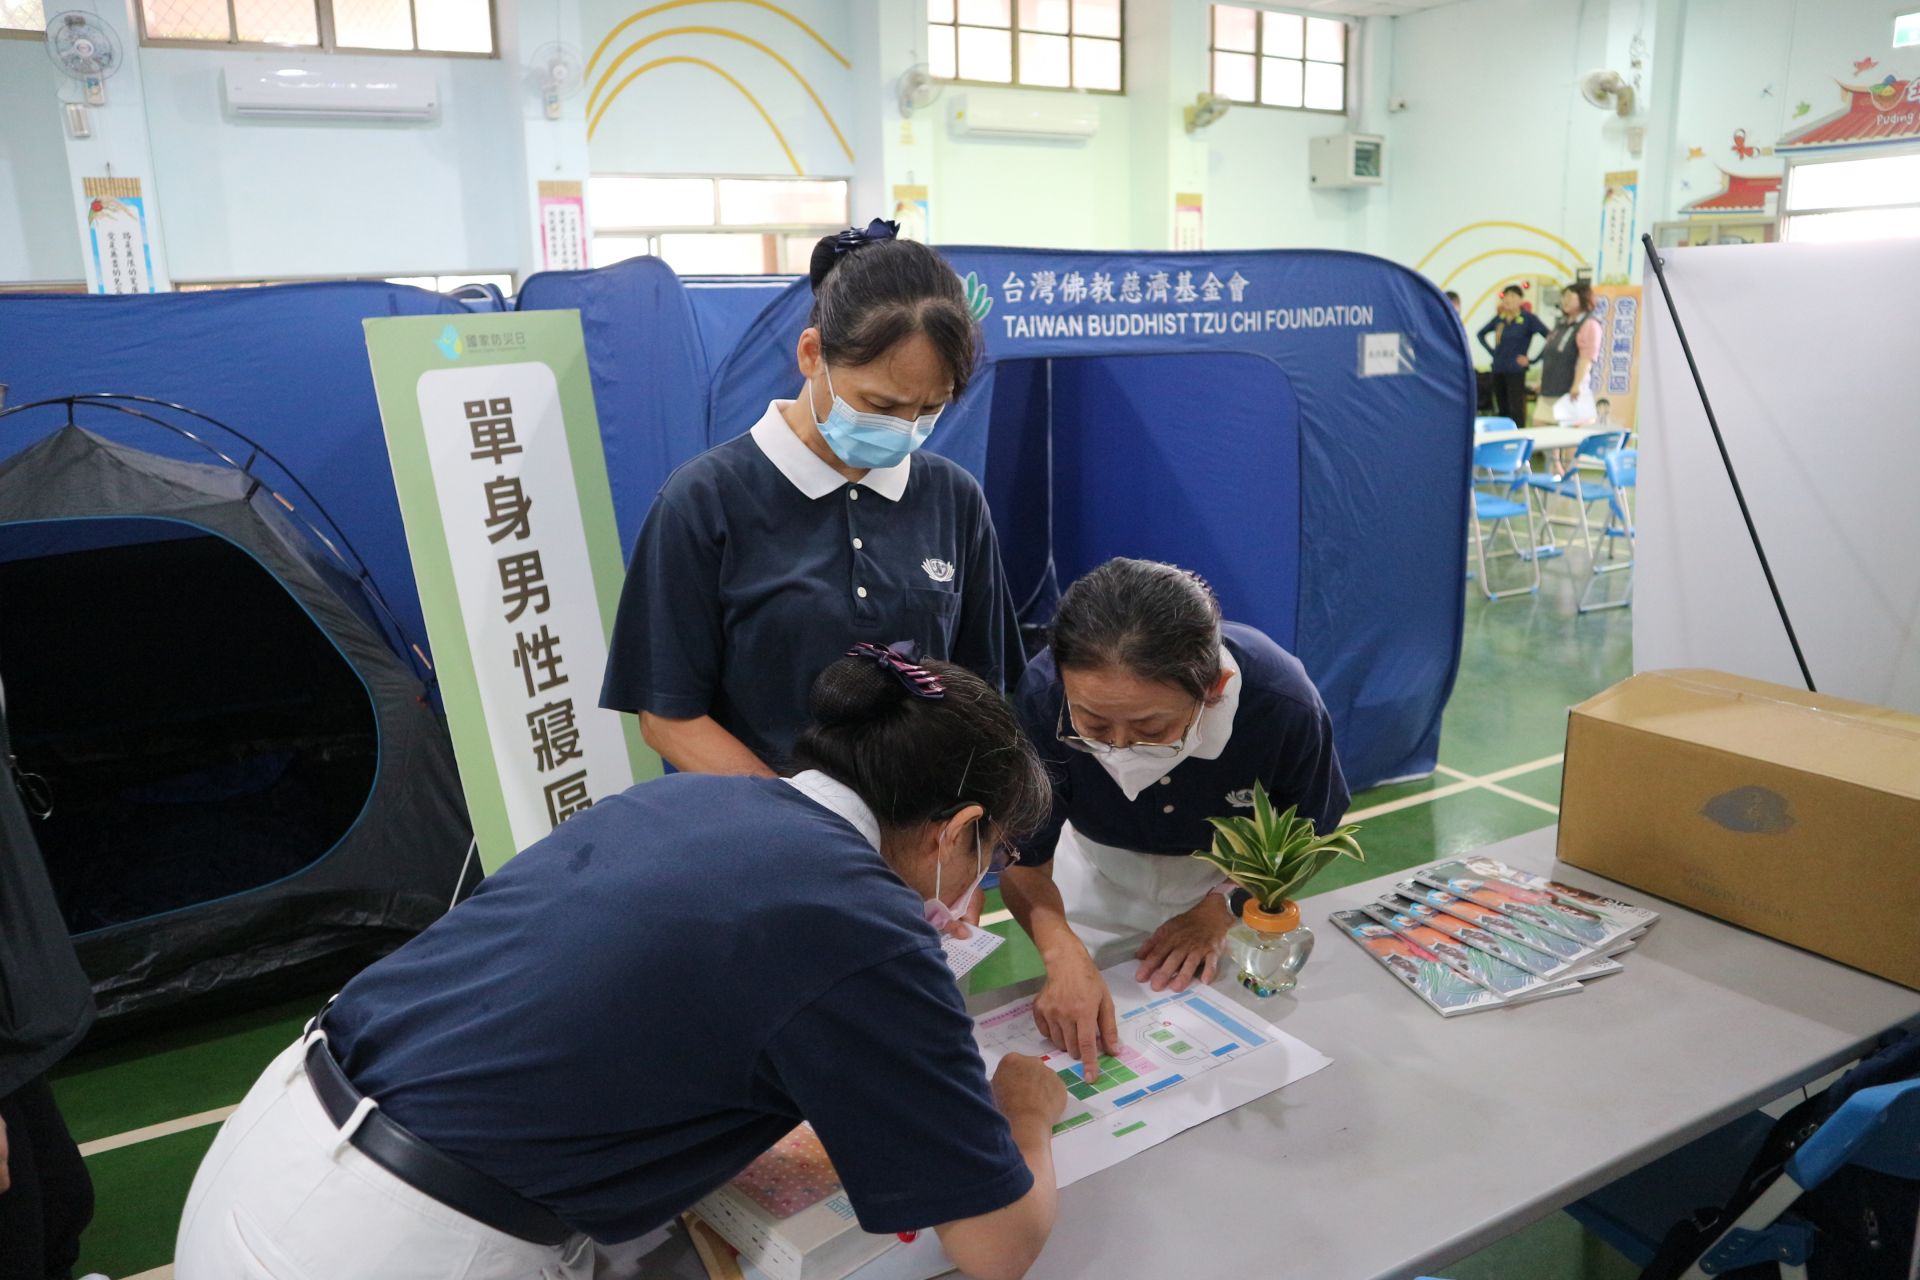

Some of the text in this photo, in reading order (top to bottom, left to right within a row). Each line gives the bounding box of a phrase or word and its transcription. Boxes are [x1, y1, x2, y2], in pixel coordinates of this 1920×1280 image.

[1876, 111, 1914, 125] Puding
[1002, 271, 1250, 303] 台灣佛教慈濟基金會
[1003, 305, 1374, 338] TAIWAN BUDDHIST TZU CHI FOUNDATION
[465, 331, 526, 348] 國家防災日
[463, 396, 593, 828] 單身男性寢區
